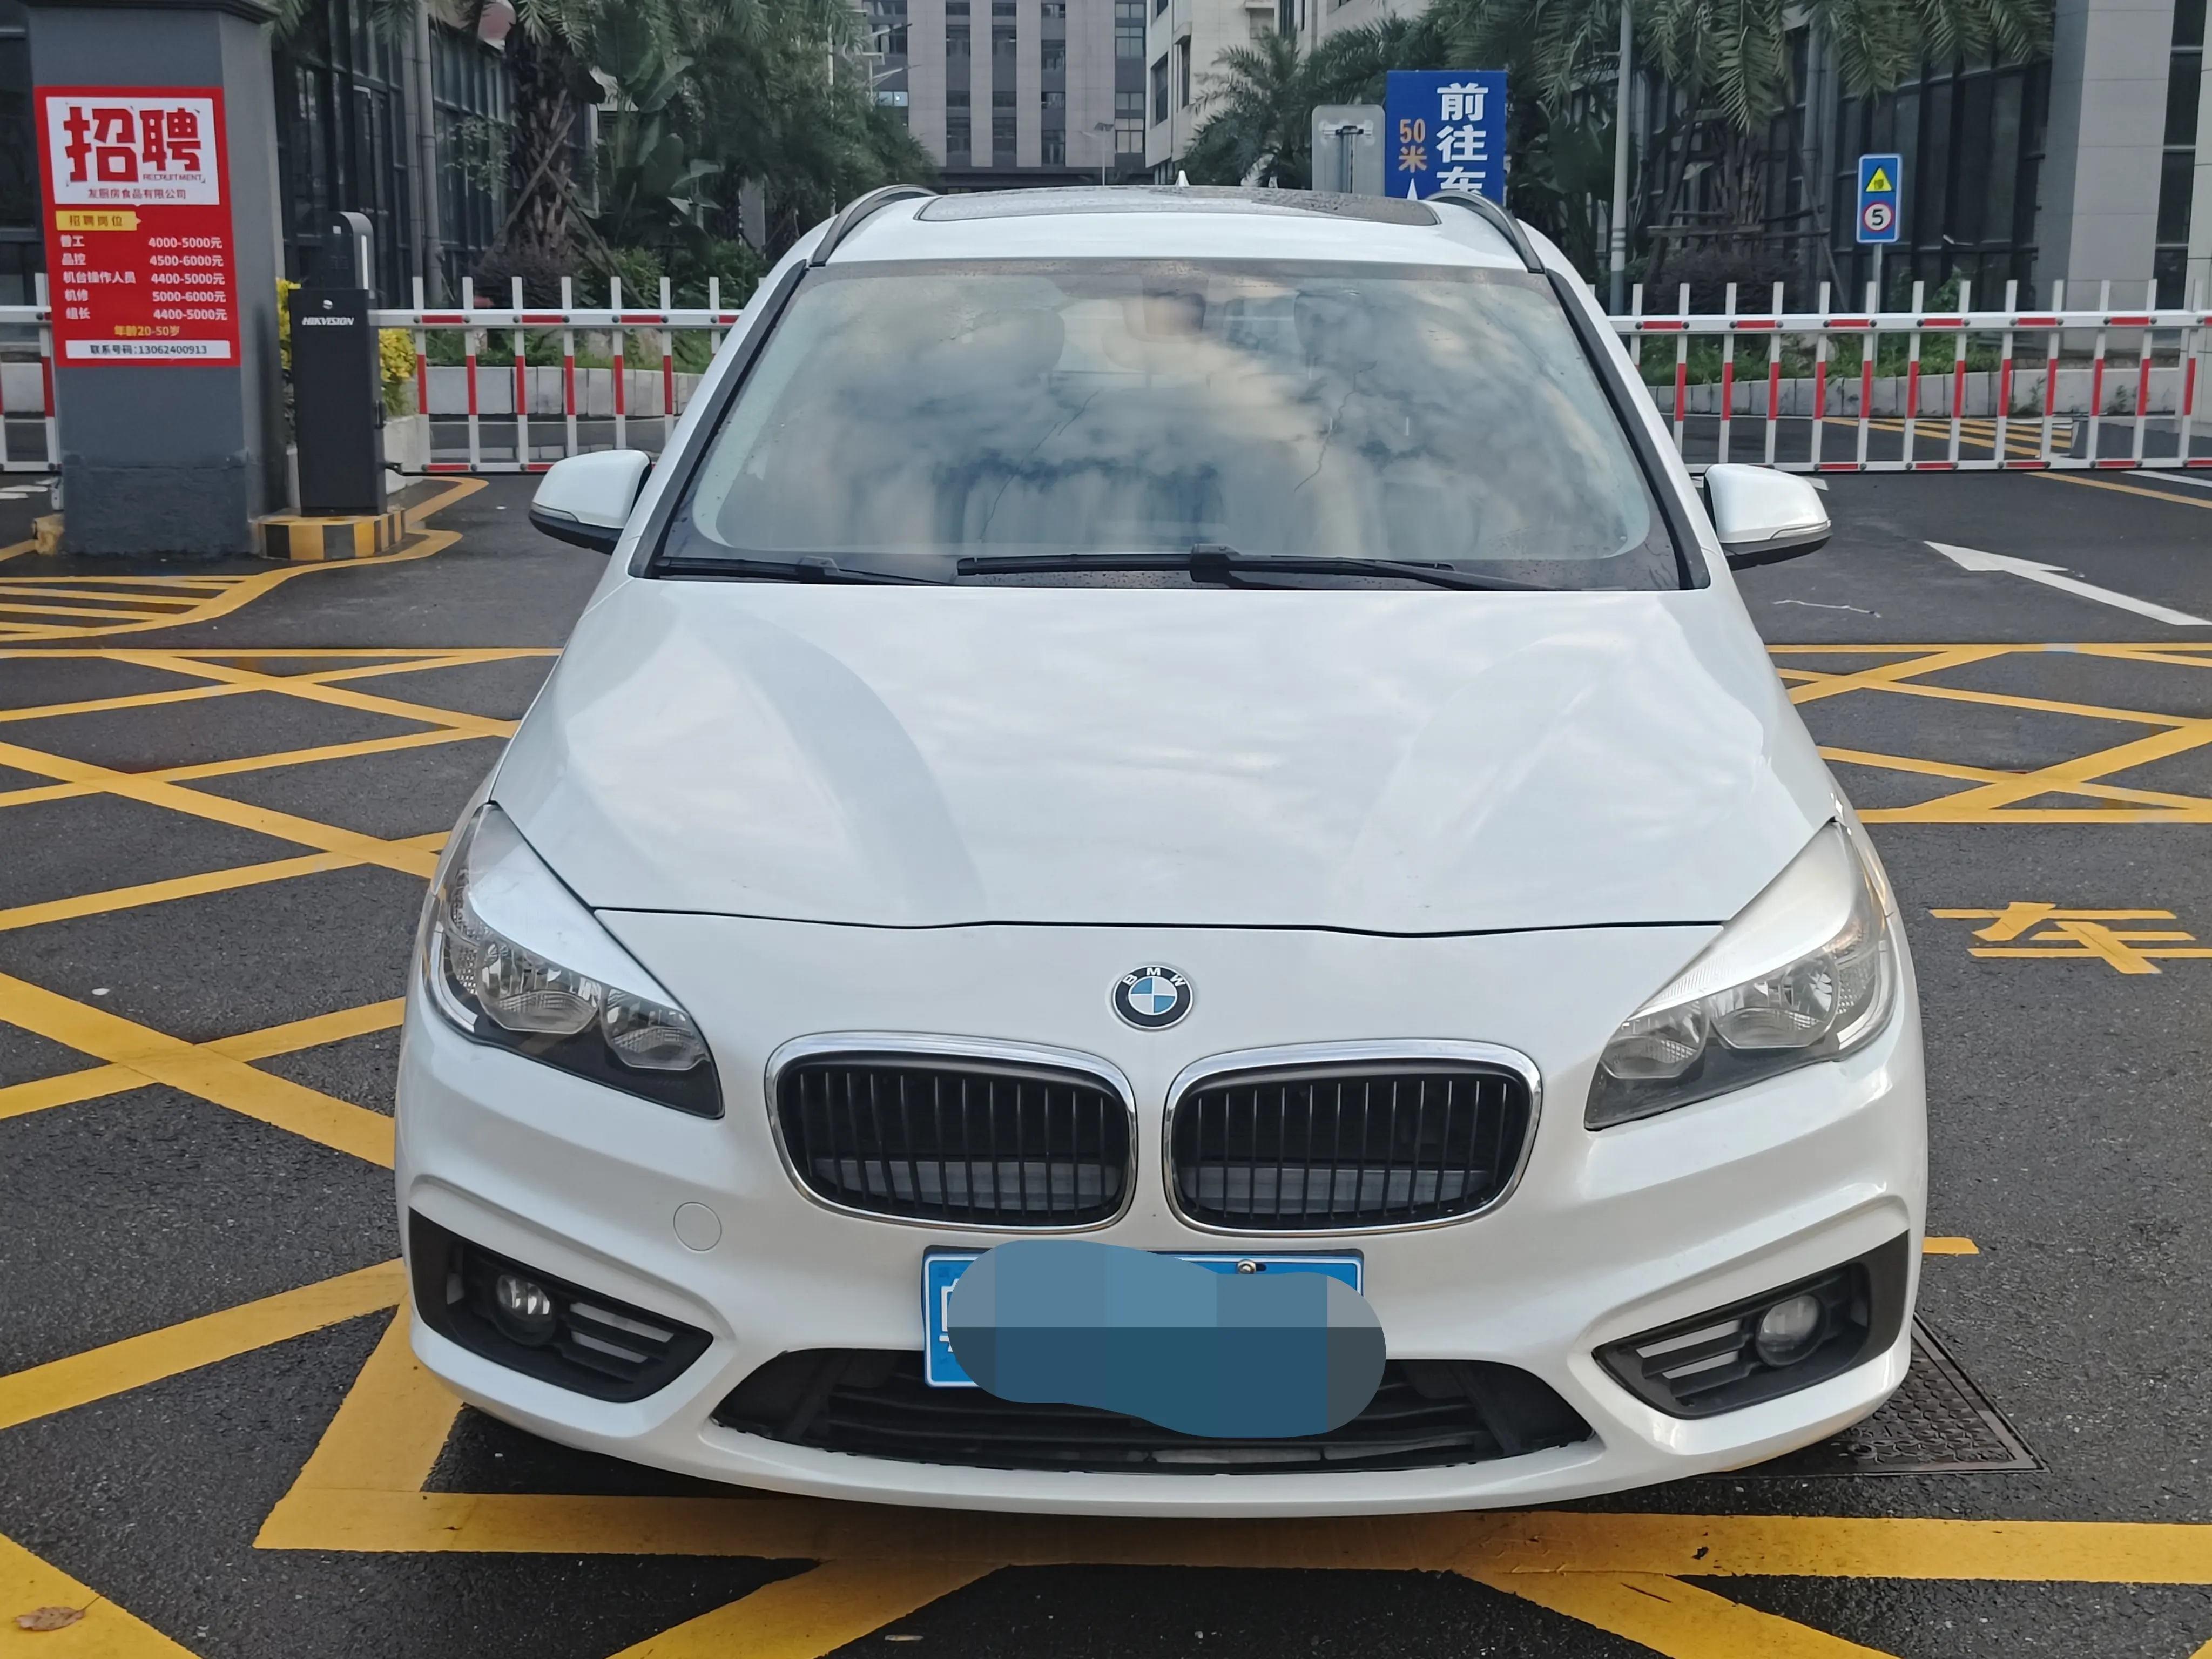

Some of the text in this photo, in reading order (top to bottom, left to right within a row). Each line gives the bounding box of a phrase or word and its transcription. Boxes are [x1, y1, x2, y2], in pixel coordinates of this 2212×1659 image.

[63, 106, 202, 183] 招聘
[143, 173, 202, 181] RECRUITMENT
[69, 215, 123, 227] 招聘岗位
[1872, 208, 1884, 226] 5
[60, 234, 85, 248] 普工
[148, 237, 222, 249] 4000-5000元
[62, 252, 87, 266] 品控
[149, 255, 224, 267] 4500-6000元
[63, 271, 137, 284] 机台操作人员
[151, 273, 225, 285] 4400-5000元
[64, 288, 89, 301] 机修
[152, 291, 226, 303] 5000-6000元
[66, 307, 91, 320] 组长
[153, 308, 228, 321] 4400-5000元
[302, 316, 354, 326] HIKVISION
[114, 325, 180, 337] 年龄20-50岁
[1122, 967, 1186, 987] BMW
